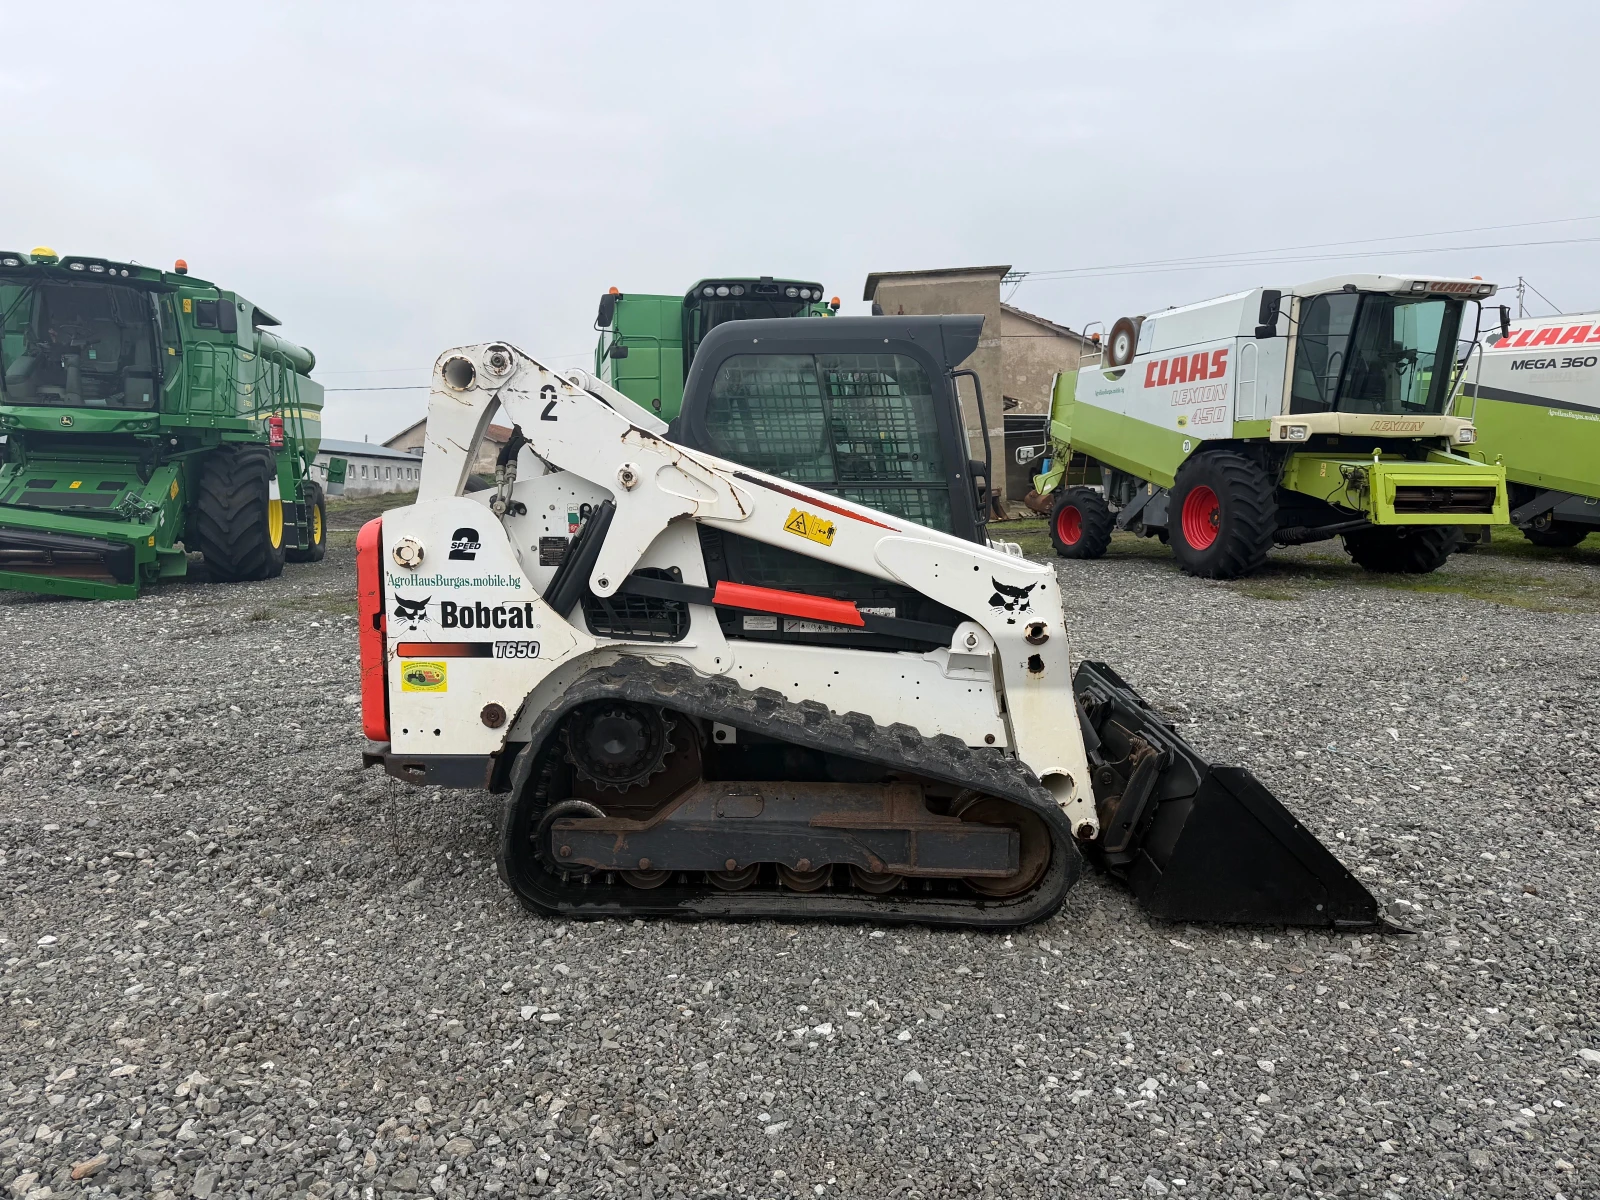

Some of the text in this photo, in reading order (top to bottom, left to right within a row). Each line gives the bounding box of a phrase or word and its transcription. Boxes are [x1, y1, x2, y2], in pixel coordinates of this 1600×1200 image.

[1430, 282, 1478, 293] CLAAS
[1144, 348, 1229, 389] CLAAS
[1510, 356, 1598, 371] MEGA 360
[540, 384, 558, 422] 2
[1170, 383, 1228, 407] LEXION
[1190, 405, 1227, 426] 450
[1370, 420, 1425, 432] LEXION
[448, 527, 480, 561] 2
[450, 541, 482, 550] SPEED
[387, 573, 521, 589] AgroHausBurgas.mobile.bg
[441, 601, 534, 629] Bobcat
[495, 641, 540, 659] T650
